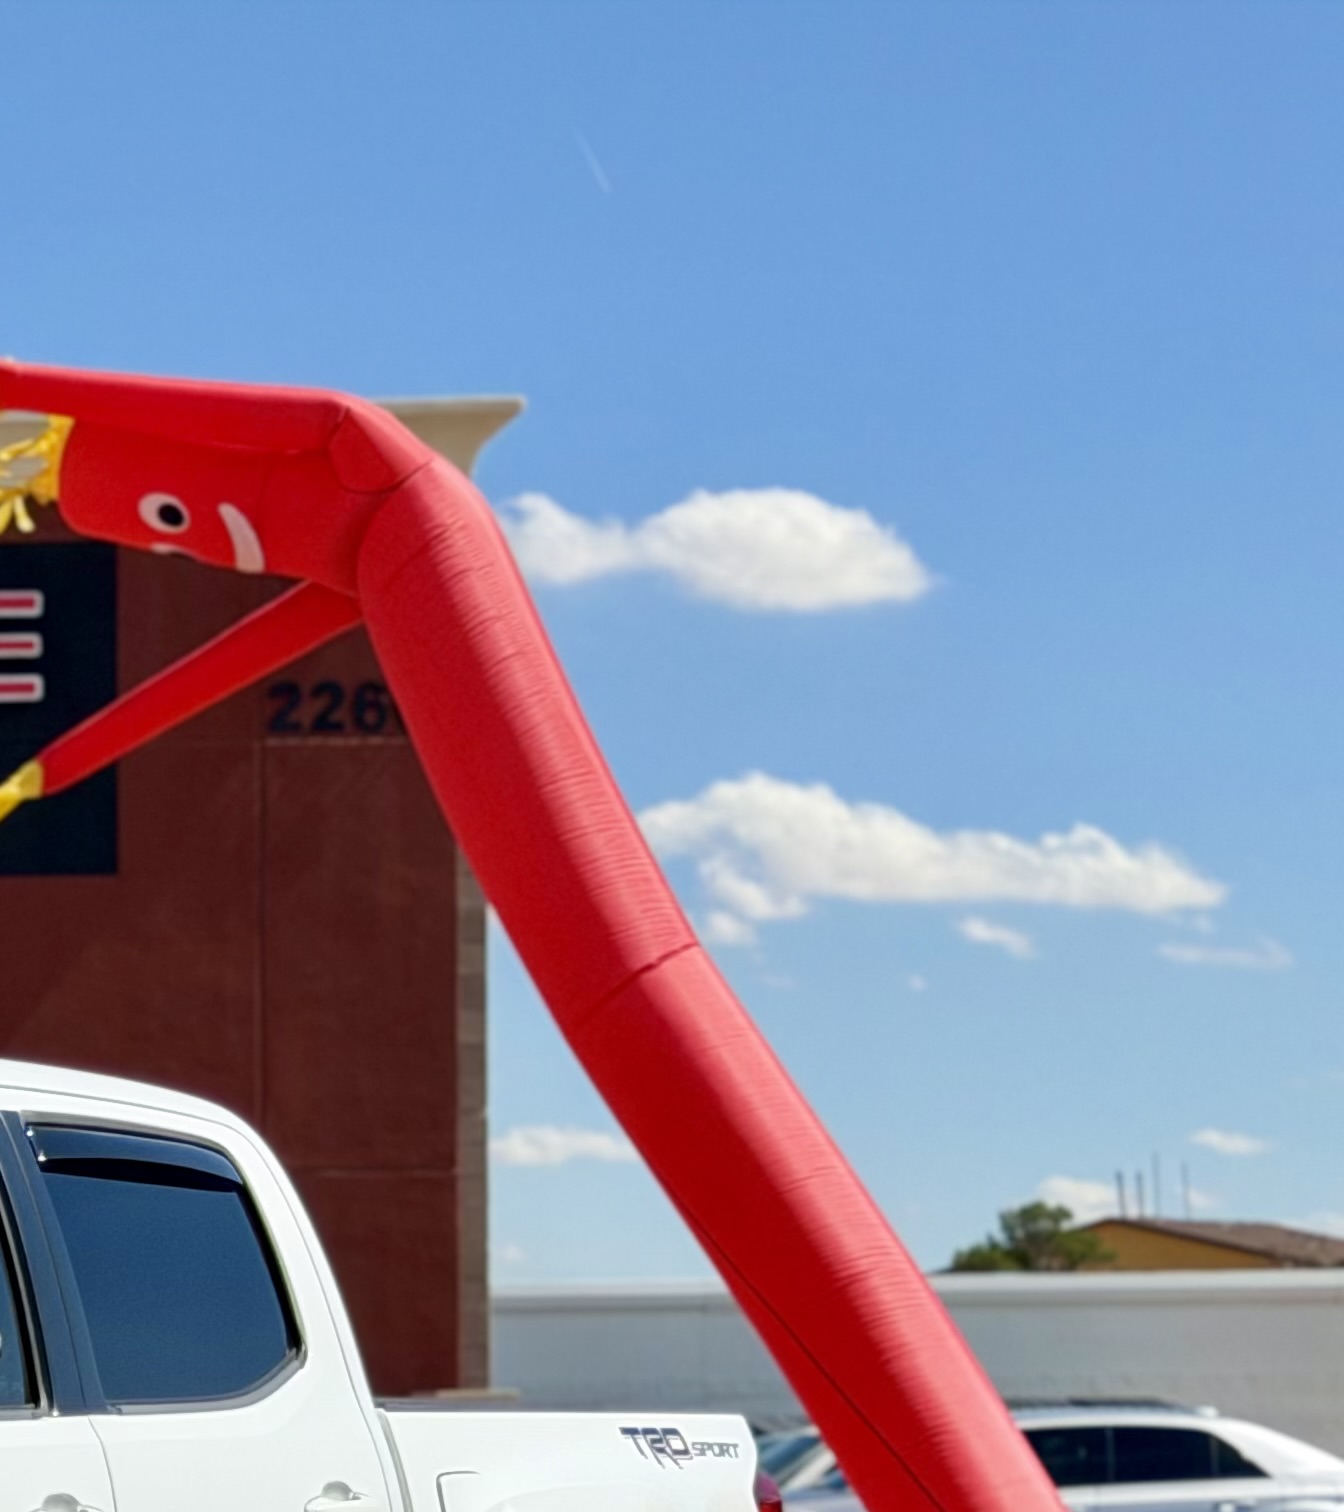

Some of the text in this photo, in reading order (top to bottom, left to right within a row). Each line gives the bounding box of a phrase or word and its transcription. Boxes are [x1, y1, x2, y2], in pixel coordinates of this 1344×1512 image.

[267, 679, 410, 734] 226
[618, 1426, 740, 1470] TRD SPORT
